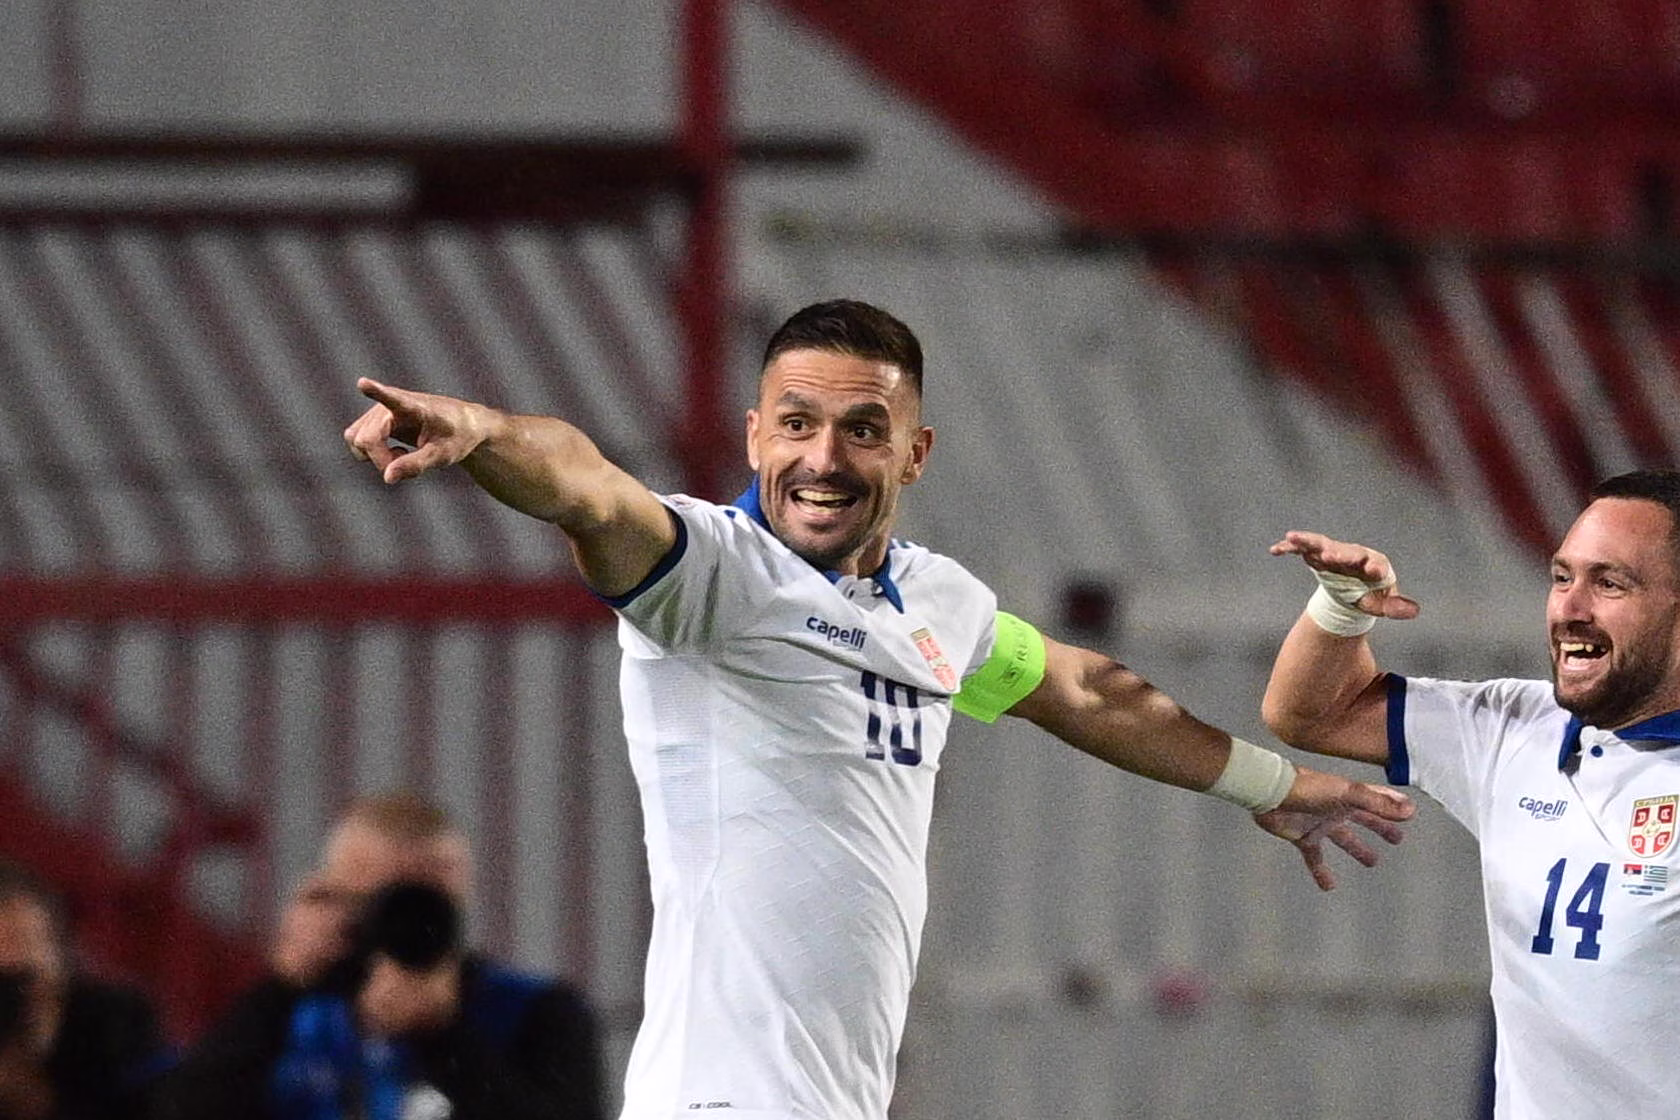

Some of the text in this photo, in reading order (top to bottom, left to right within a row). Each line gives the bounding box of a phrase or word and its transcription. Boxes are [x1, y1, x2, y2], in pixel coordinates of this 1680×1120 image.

[806, 616, 867, 649] capelli
[861, 670, 923, 767] 10
[1518, 796, 1568, 817] capelli
[1531, 858, 1611, 960] 14
